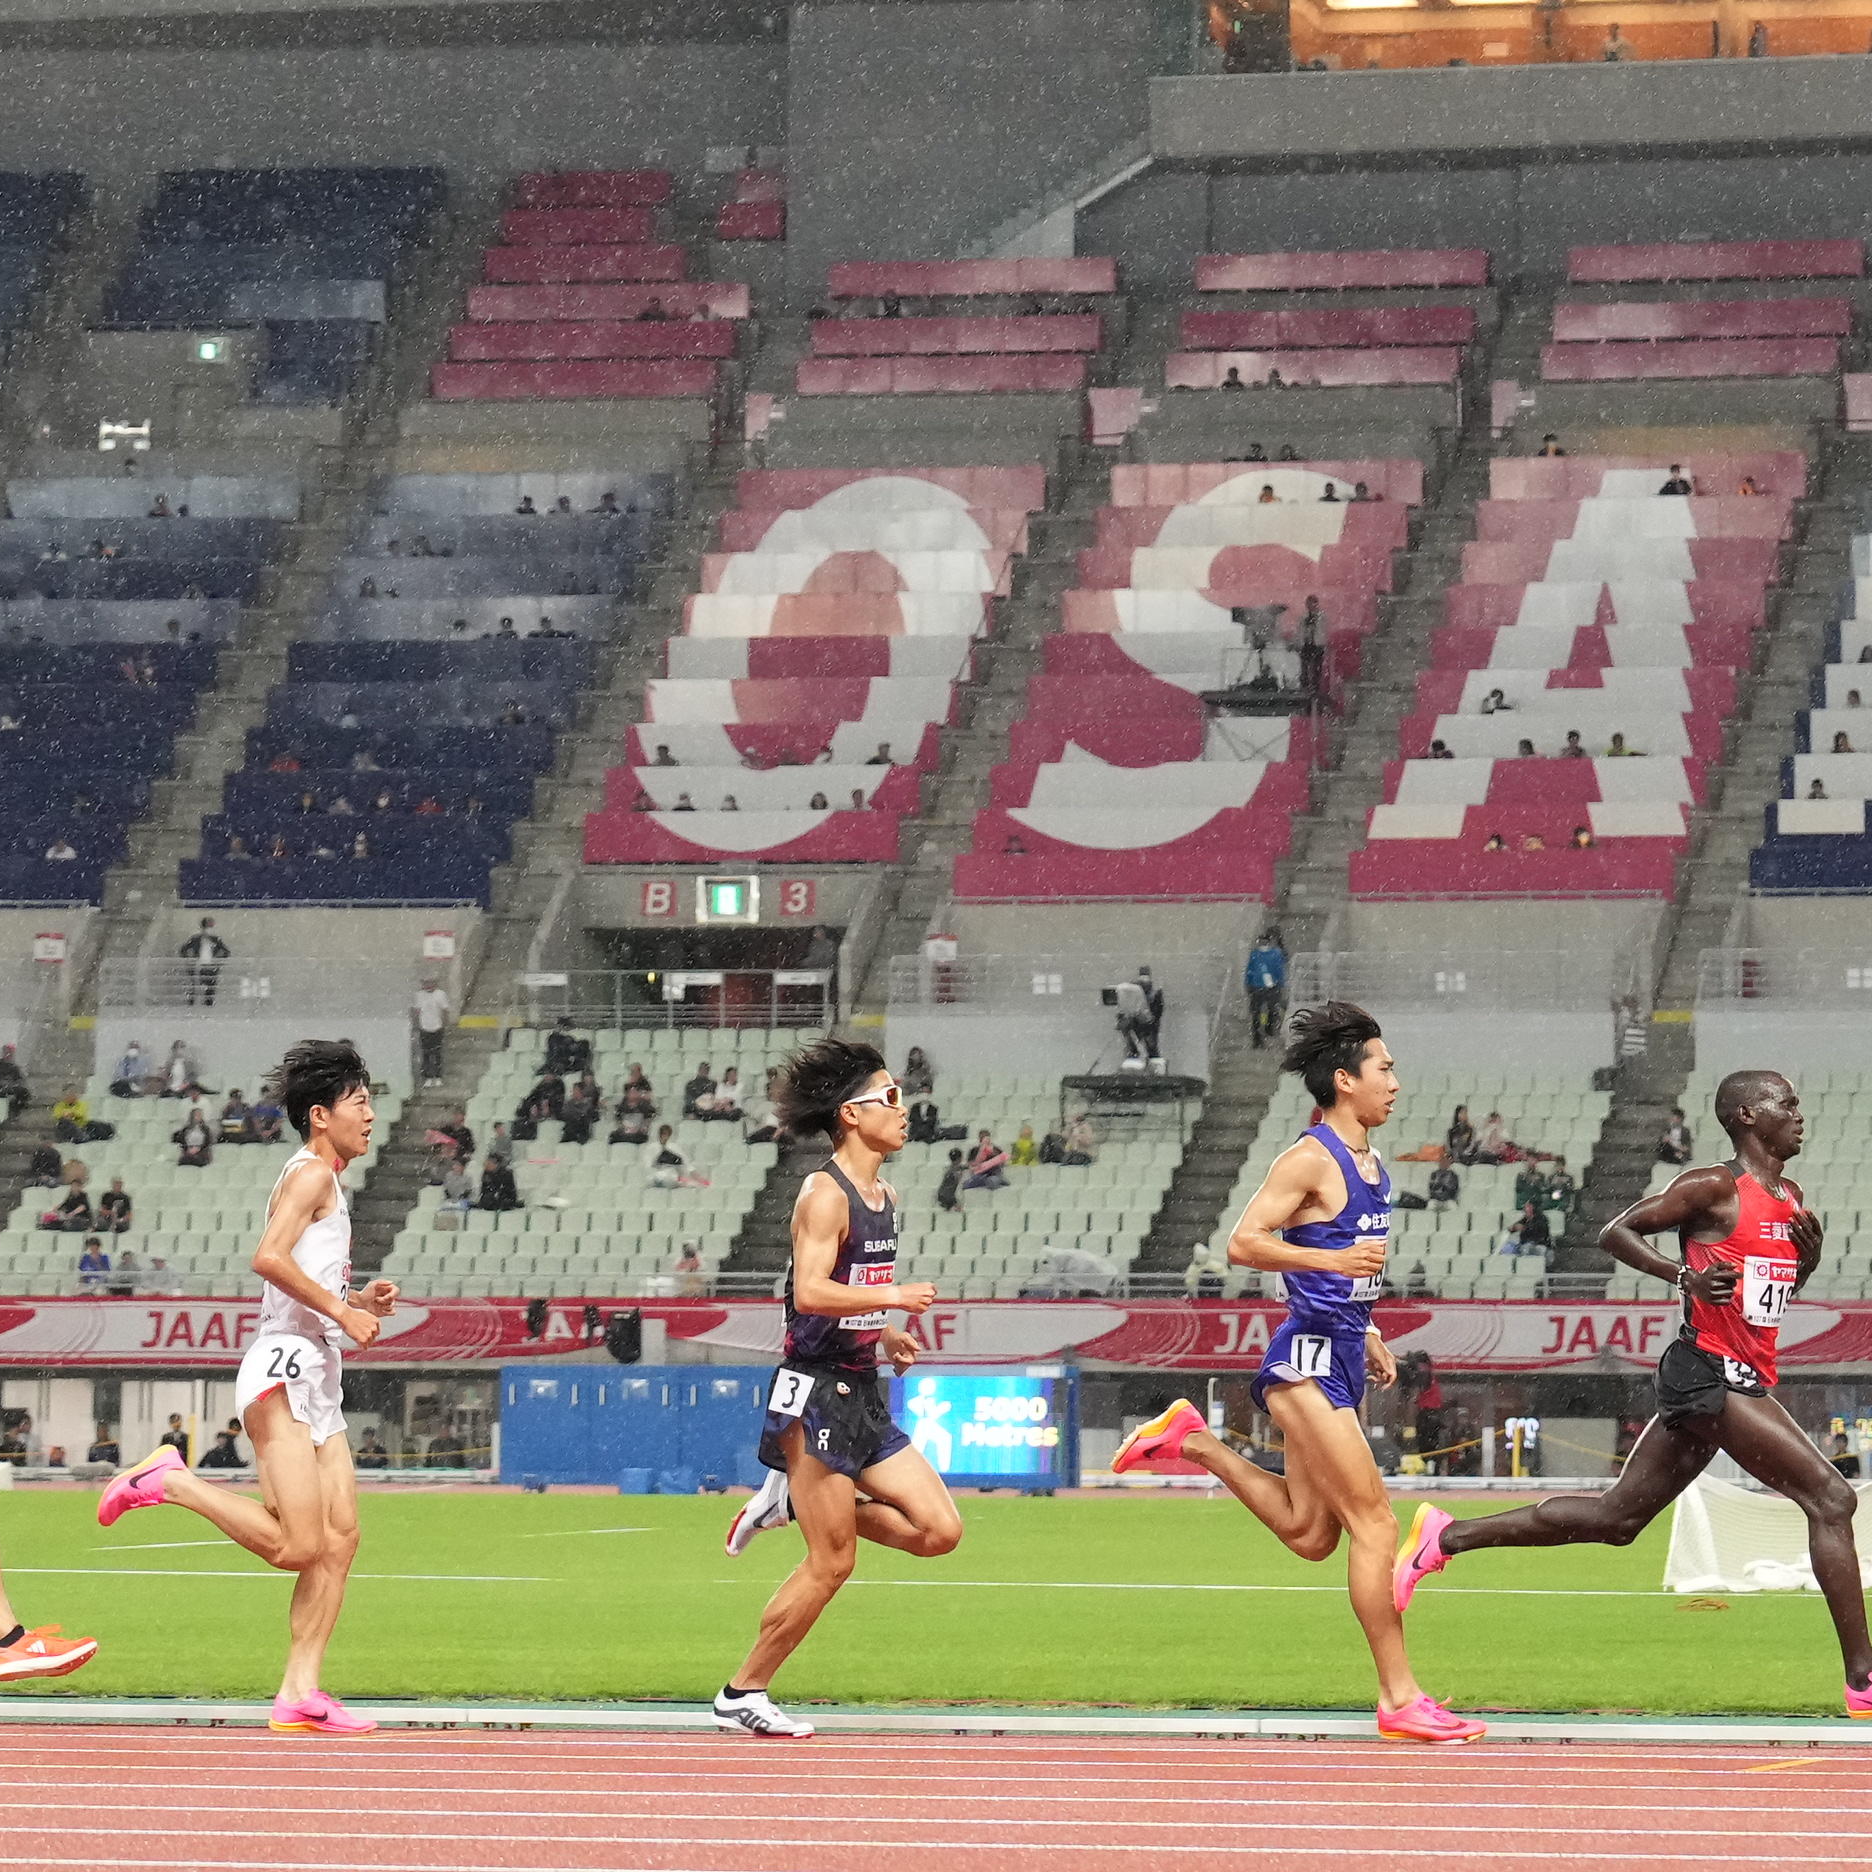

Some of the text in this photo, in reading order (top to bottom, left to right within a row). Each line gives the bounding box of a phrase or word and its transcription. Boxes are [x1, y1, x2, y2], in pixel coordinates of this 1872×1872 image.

[645, 882, 808, 914] B 3
[140, 1309, 261, 1349] JAAF
[905, 1312, 956, 1351] AF
[1214, 1314, 1271, 1353] JA
[1541, 1315, 1666, 1354] JAAF
[267, 1347, 302, 1379] 26
[1297, 1338, 1325, 1371] 17
[781, 1376, 801, 1409] 3
[974, 1396, 1048, 1422] 5000
[960, 1422, 1059, 1447] Metres
